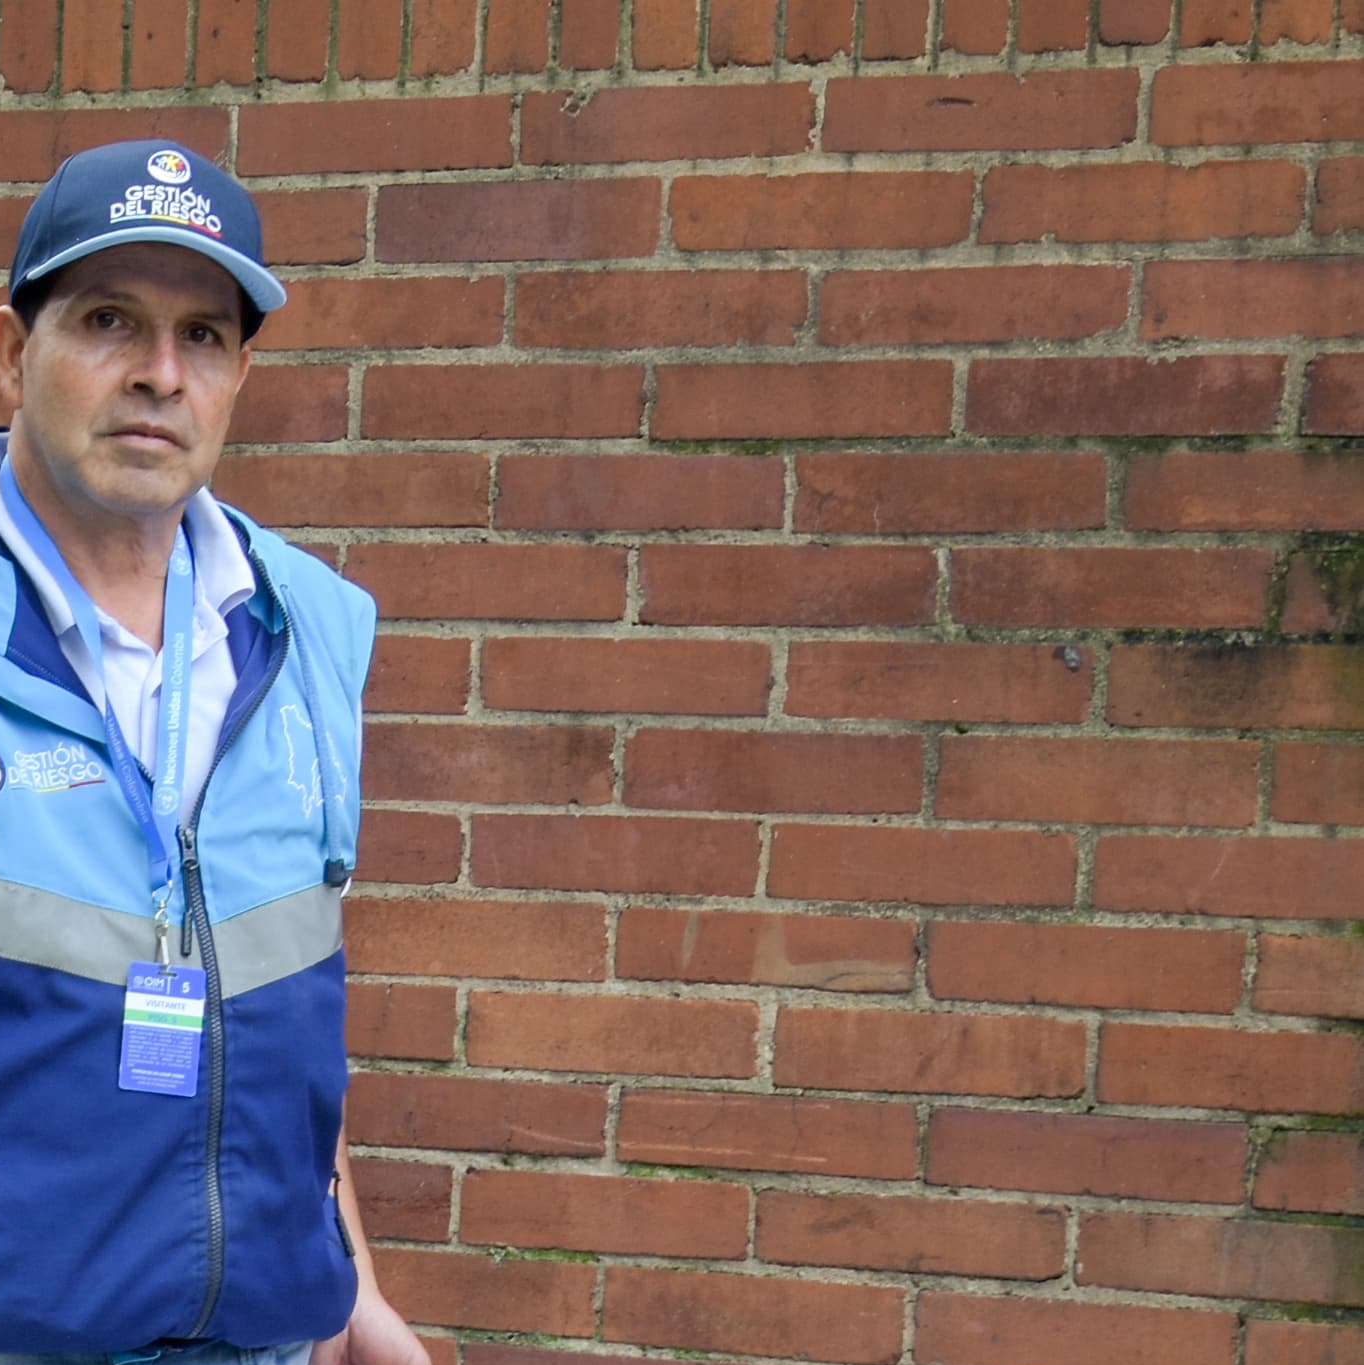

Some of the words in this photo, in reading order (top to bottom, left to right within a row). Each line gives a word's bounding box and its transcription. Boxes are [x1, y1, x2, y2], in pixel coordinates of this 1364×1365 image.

[125, 185, 211, 214] GESTIÓN
[110, 202, 146, 218] DEL
[151, 200, 222, 233] RIESGO
[171, 632, 185, 685] Colombia
[167, 690, 182, 730] Unidas
[35, 761, 102, 788] RIESGO
[163, 731, 179, 785] Naciones
[182, 982, 191, 993] 5
